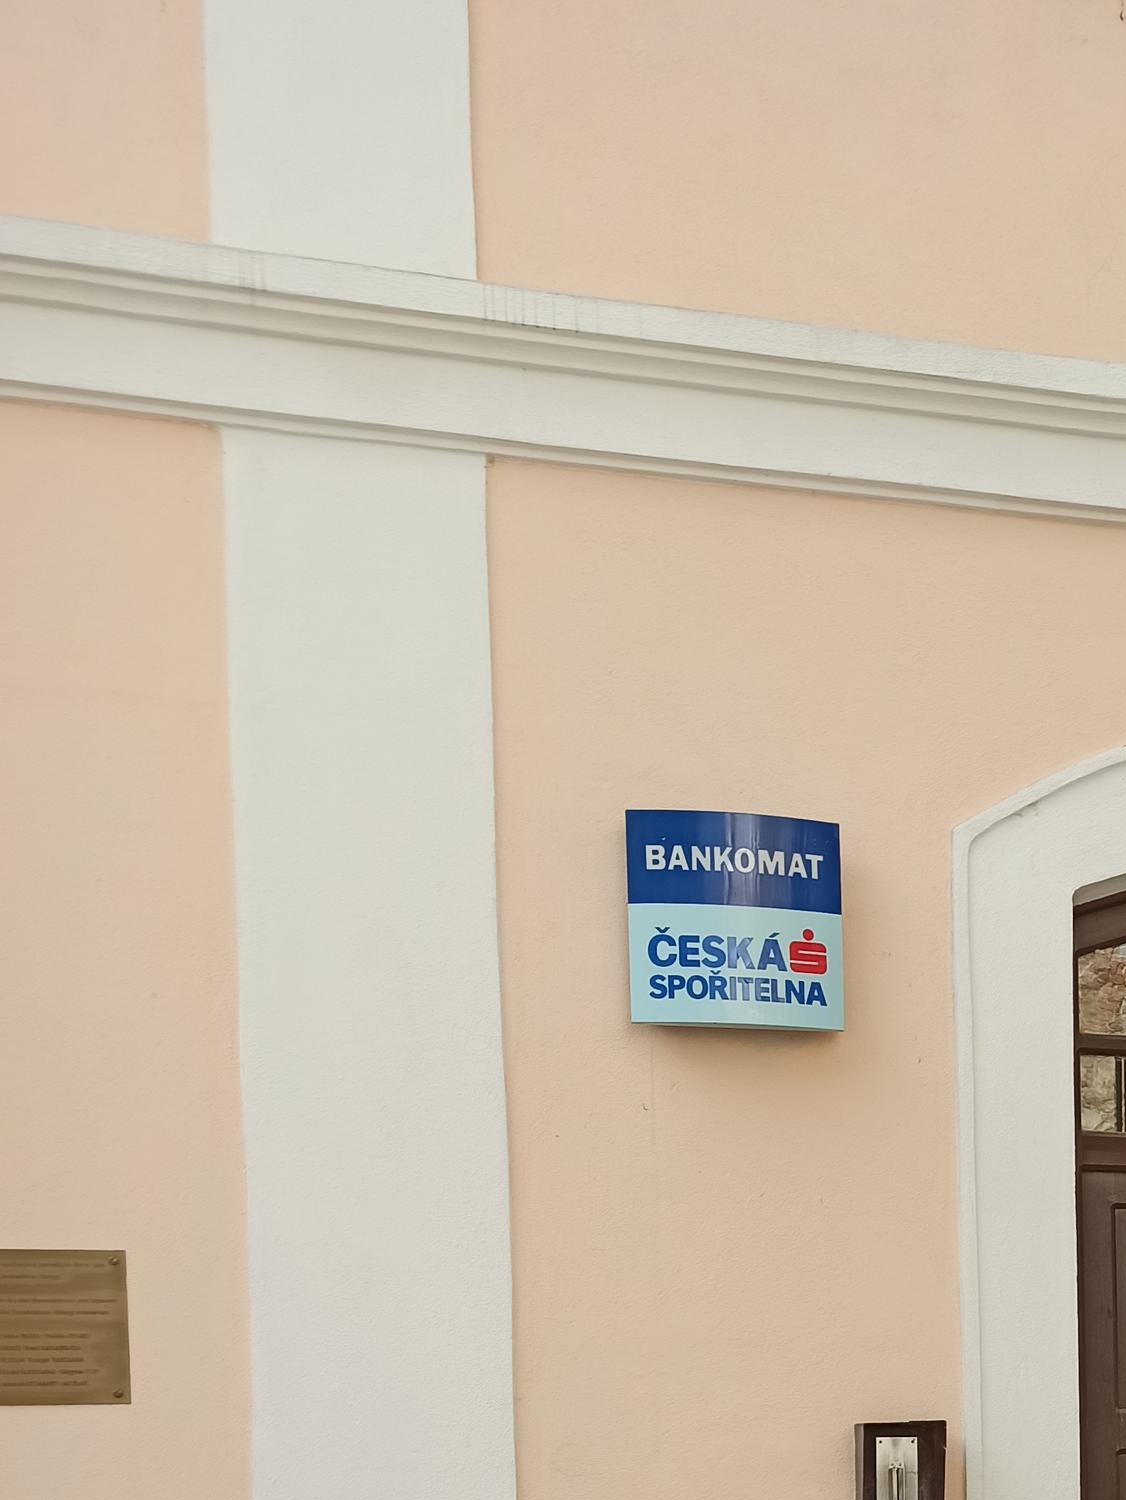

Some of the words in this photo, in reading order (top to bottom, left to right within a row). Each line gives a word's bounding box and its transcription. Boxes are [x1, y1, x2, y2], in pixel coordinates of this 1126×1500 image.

[645, 845, 824, 880] BANKOMAT
[647, 926, 788, 972] ČESKÁ
[649, 970, 828, 1007] SPOŘITELNA
